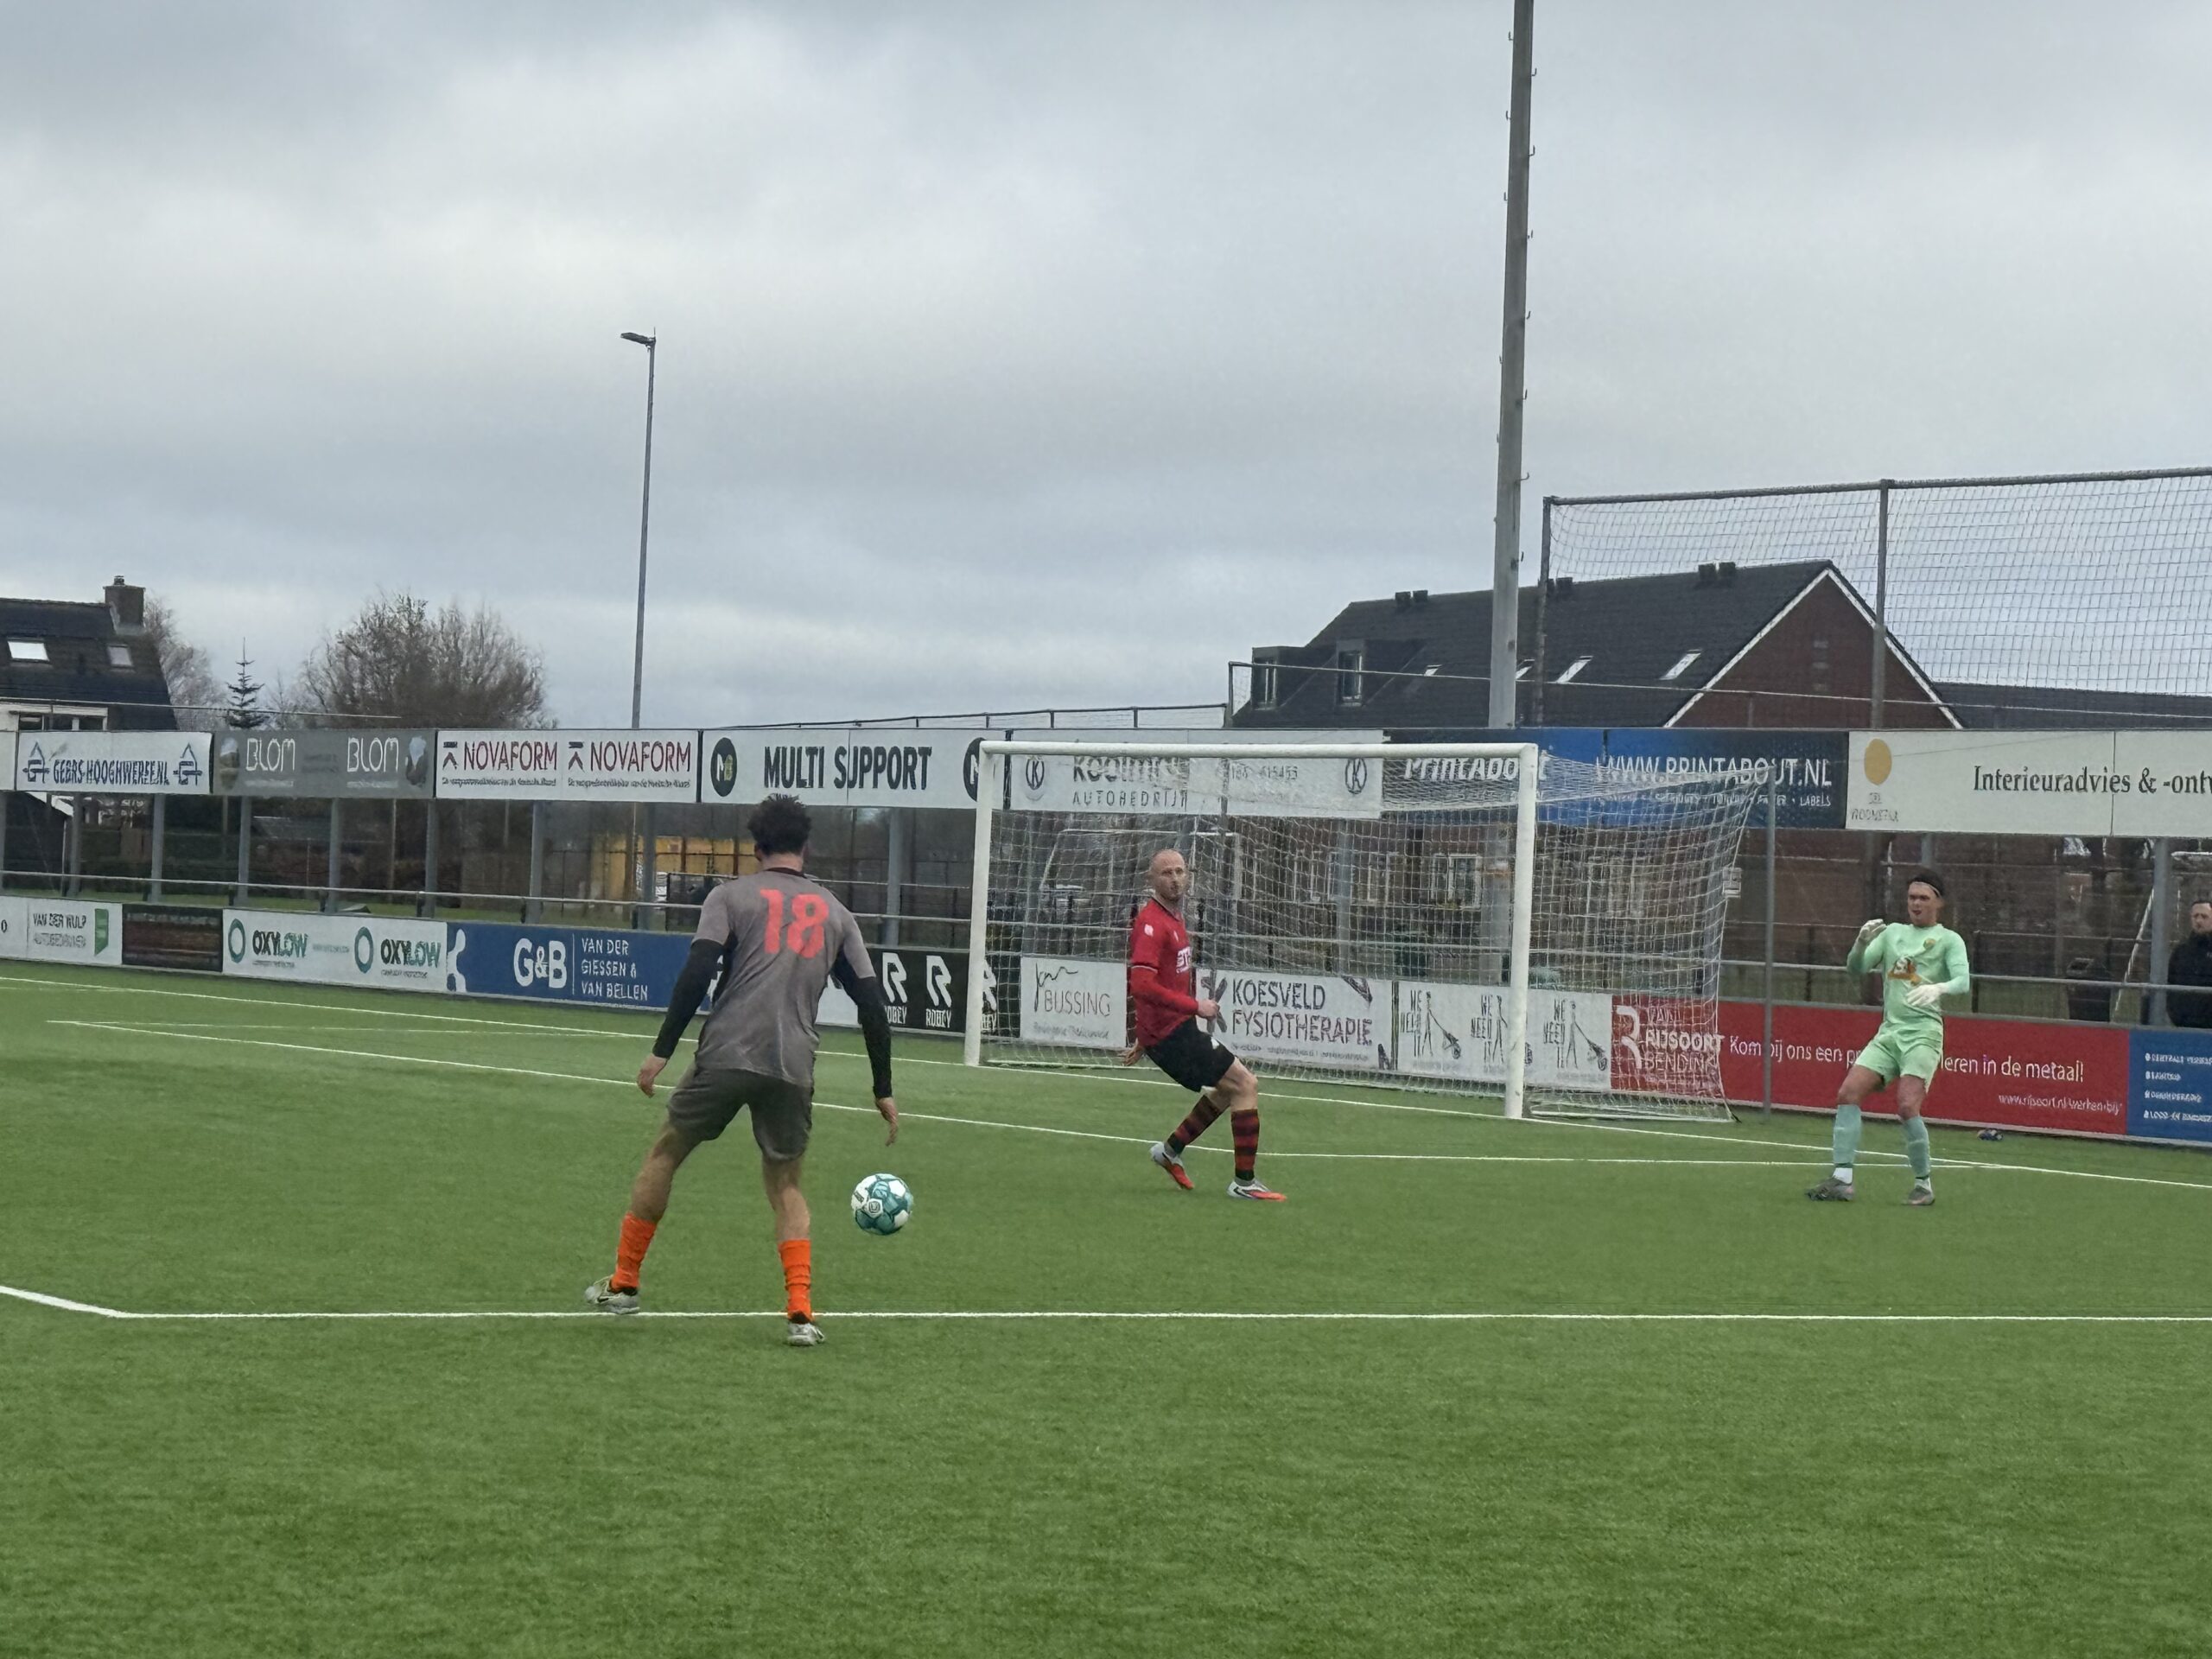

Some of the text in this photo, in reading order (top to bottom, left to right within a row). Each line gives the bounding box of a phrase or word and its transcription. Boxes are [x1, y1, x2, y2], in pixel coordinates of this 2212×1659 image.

[245, 738, 296, 772] BLOM
[346, 737, 399, 772] BLOM
[463, 741, 558, 772] NOVAFORM
[589, 741, 691, 772] NOVAFORM
[764, 746, 825, 789] MULTI
[834, 746, 932, 790] SUPPORT
[1974, 766, 2131, 794] Interieuradvies
[2138, 766, 2158, 794] &
[760, 888, 830, 959] 18
[252, 930, 308, 958] OXYLOW
[380, 938, 442, 968] OXYLOW
[581, 938, 629, 956] VAN DER
[513, 938, 568, 988] G&B
[581, 958, 626, 977] GIESSEN
[581, 980, 648, 1001] VAN BELLEN
[1232, 978, 1326, 1010] KOESVELD
[884, 1005, 907, 1024] OBEY
[1231, 1009, 1373, 1046] FYSIOTHERAPIE
[1729, 1036, 1762, 1057] Kom
[1786, 1044, 1813, 1062] ons
[1815, 1046, 1843, 1063] een
[1982, 1054, 1997, 1076] in
[2000, 1055, 2022, 1078] de
[2025, 1060, 2084, 1083] metaal!
